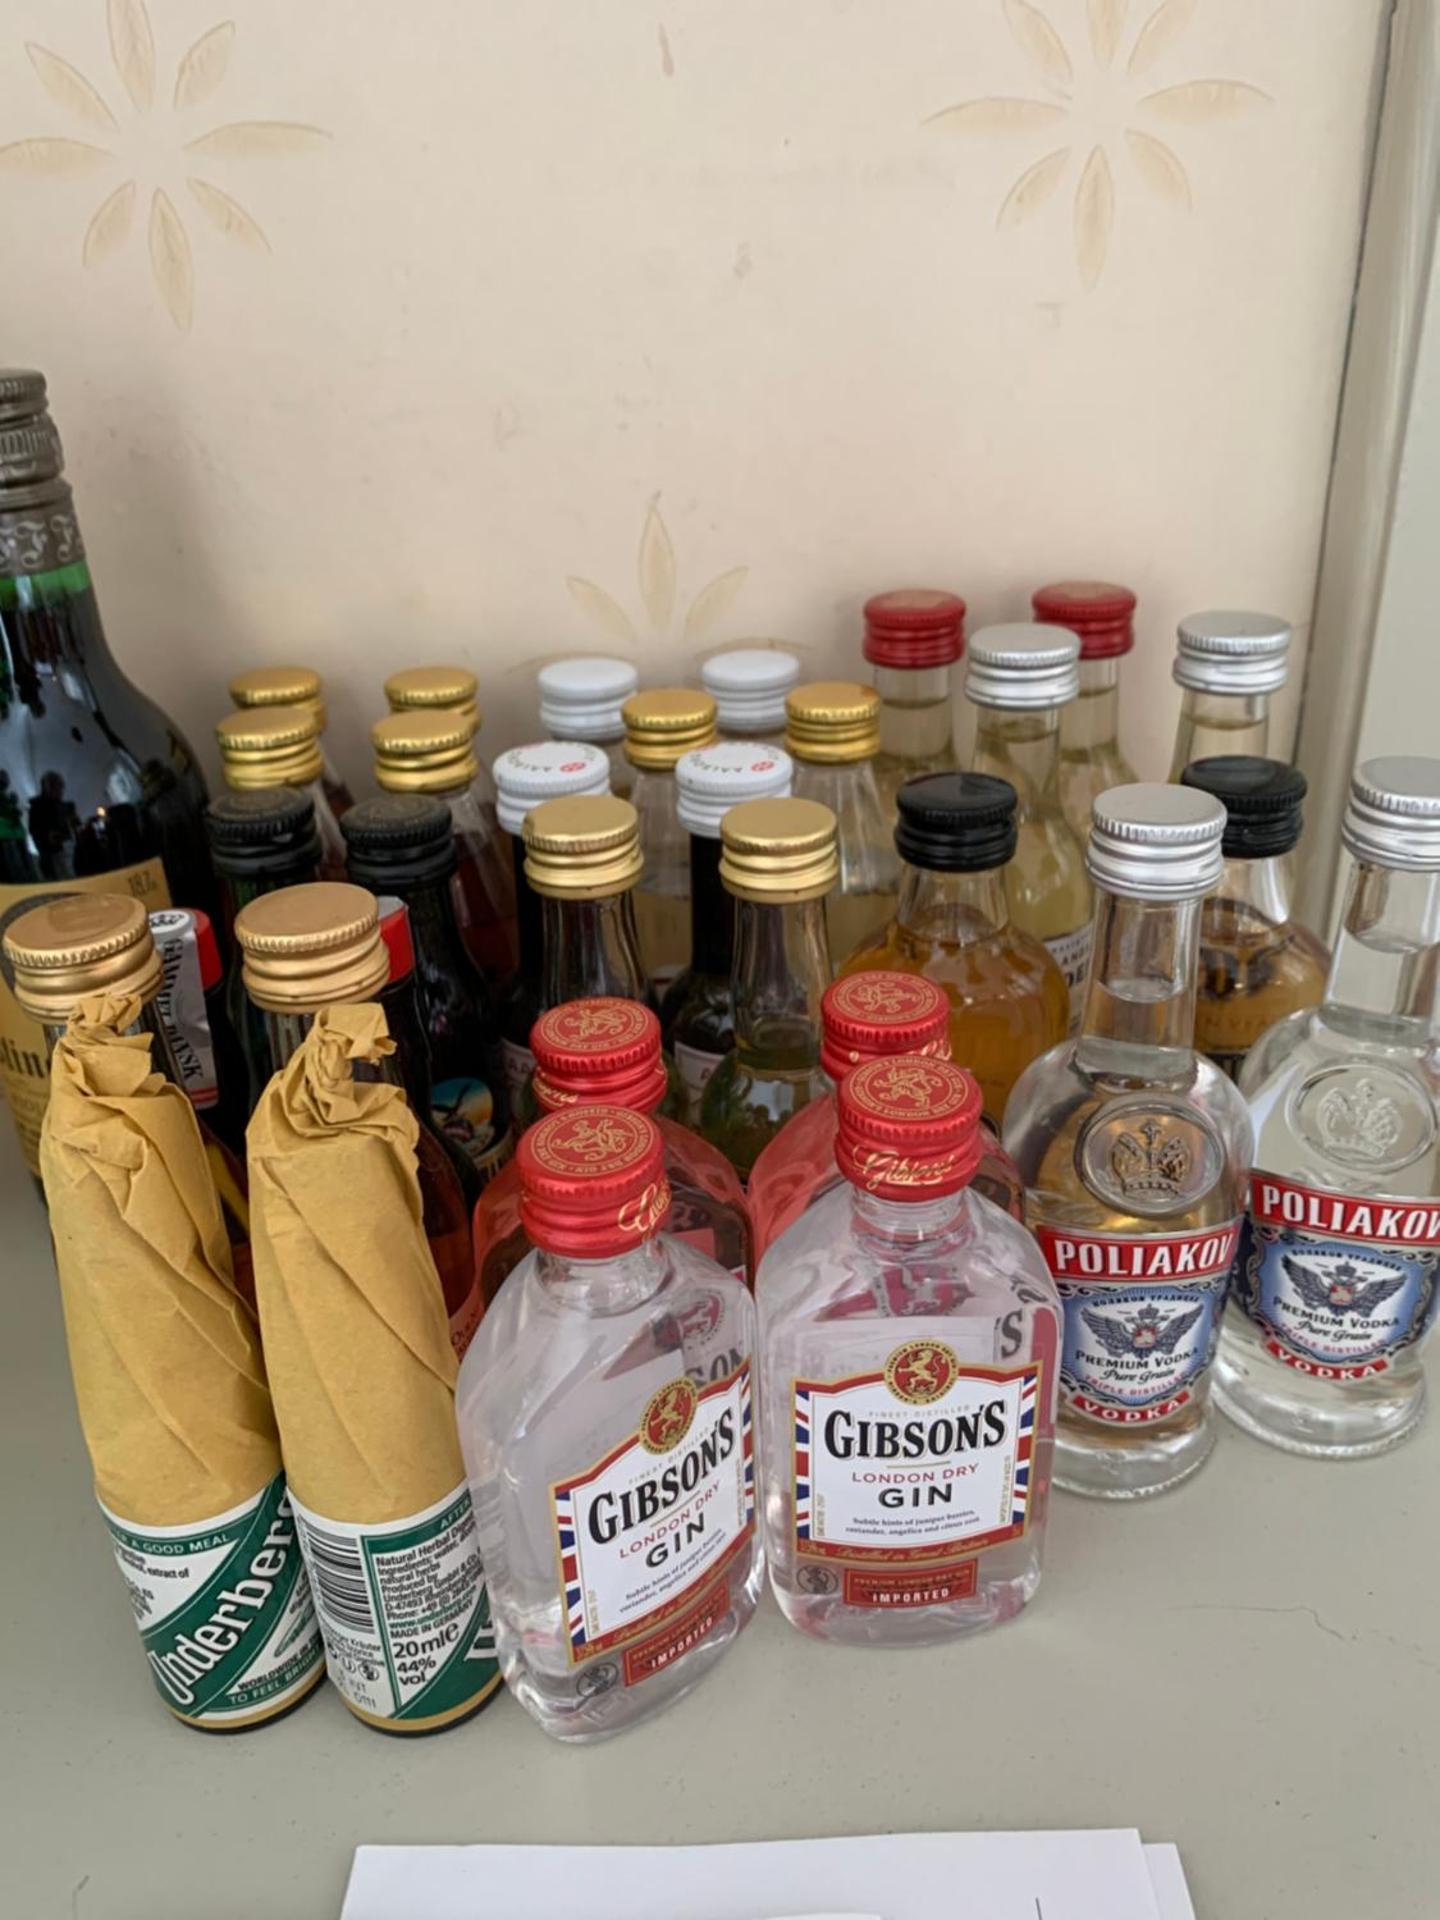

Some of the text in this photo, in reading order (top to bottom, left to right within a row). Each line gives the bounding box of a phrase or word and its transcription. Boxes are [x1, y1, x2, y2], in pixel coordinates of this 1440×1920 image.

[1262, 1184, 1440, 1240] POLIAKOV
[1054, 1233, 1234, 1276] POLIAKOV
[1273, 1295, 1399, 1329] PREMIUM VODKA
[1294, 1320, 1373, 1342] Pure Grain
[1075, 1346, 1199, 1370] PREMIUM VODKA
[1278, 1348, 1377, 1379] VODKA
[1101, 1368, 1176, 1384] Pure Grain
[1083, 1400, 1180, 1421] VODKA
[824, 1400, 1006, 1459] GIBSON'S
[588, 1408, 735, 1546] GIBSON'S
[852, 1463, 979, 1484] LONDON DRY
[878, 1484, 953, 1508] GIN
[619, 1480, 721, 1559] LONDON DRY
[142, 1542, 185, 1555] GOOD
[188, 1532, 230, 1552] MEAL
[375, 1549, 417, 1566] Natural
[418, 1530, 451, 1555] Herbal
[645, 1512, 705, 1568] GIN
[147, 1567, 190, 1579] extract of
[380, 1561, 441, 1585] natural herbs
[381, 1578, 426, 1594] Produced
[872, 1588, 950, 1603] IMPORTED
[390, 1597, 473, 1640] MADE IN GERMANY
[651, 1616, 714, 1669] IMPORTED
[397, 1655, 437, 1674] 44%
[229, 1693, 249, 1705] TO
[252, 1680, 281, 1699] FEEL
